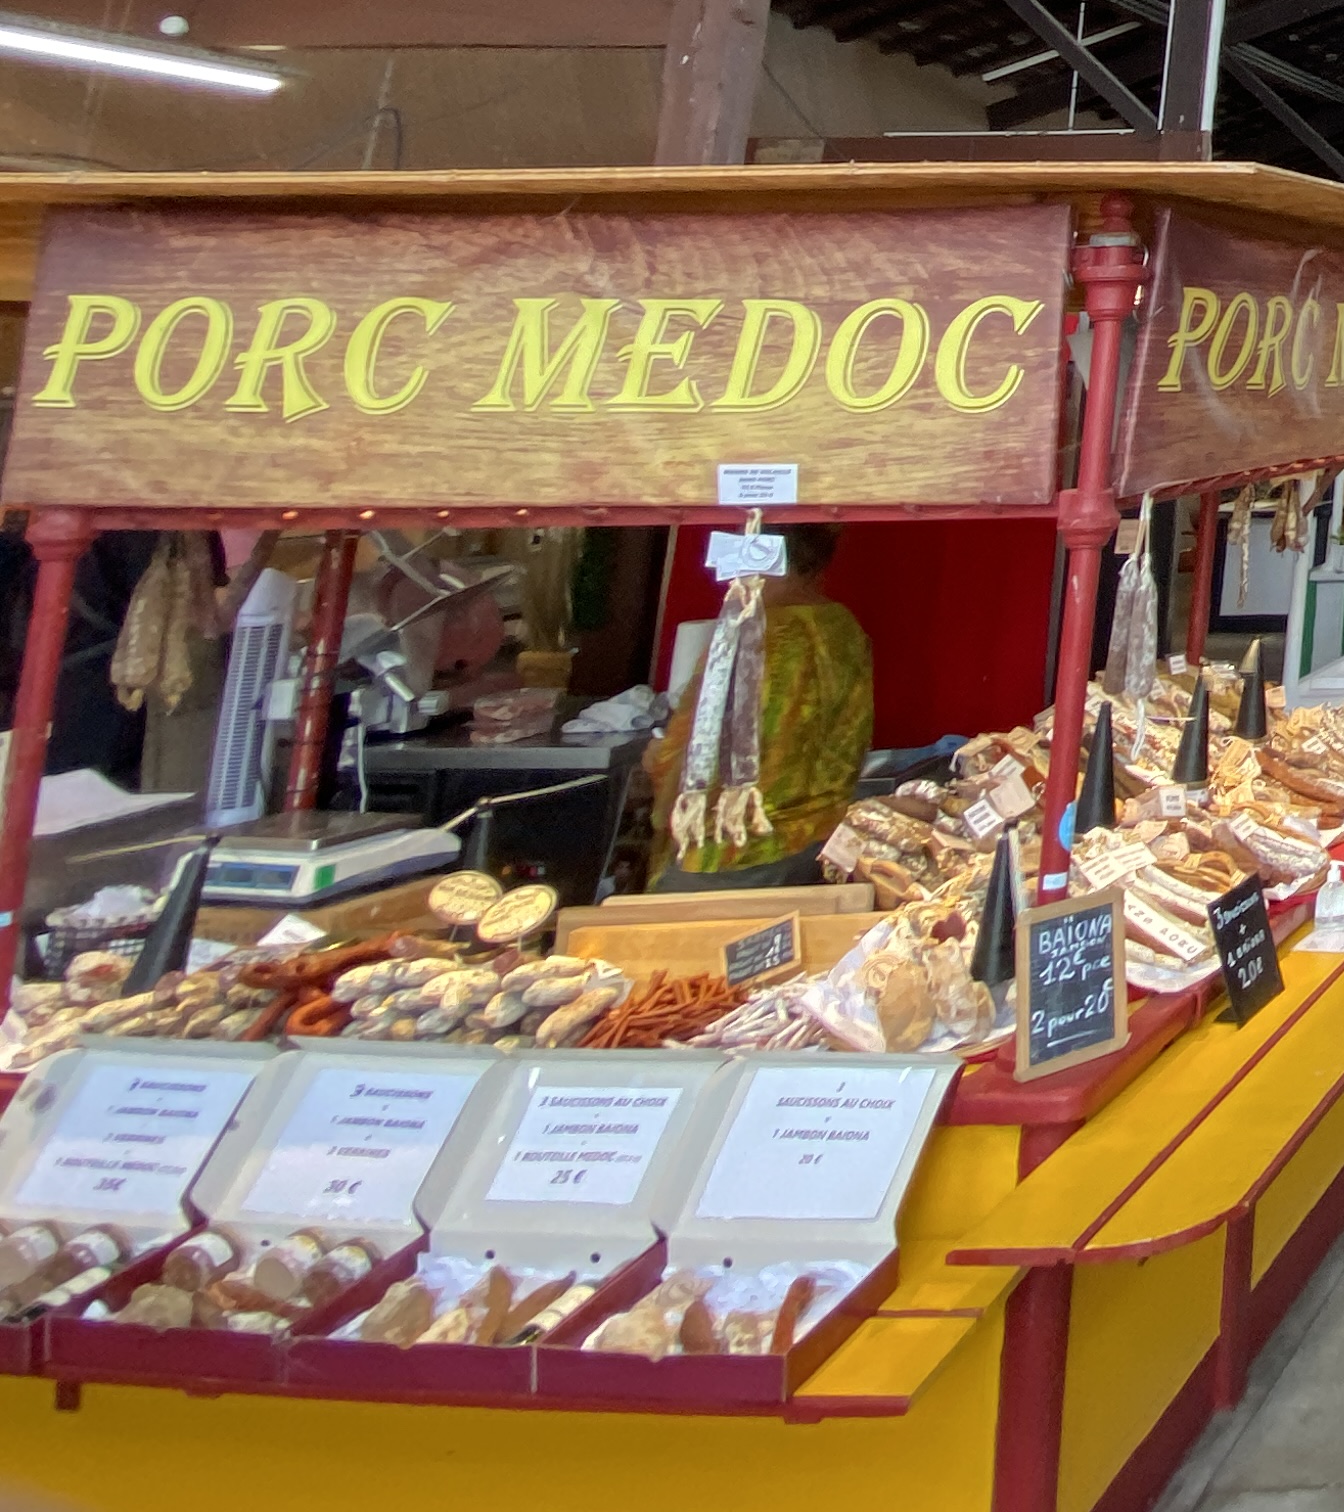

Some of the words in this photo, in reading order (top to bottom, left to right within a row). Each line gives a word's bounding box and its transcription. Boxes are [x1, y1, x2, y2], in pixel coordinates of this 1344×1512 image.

[1157, 286, 1320, 399] PORC
[31, 294, 456, 424] PORC
[469, 295, 1045, 414] MEDOC
[1038, 913, 1113, 955] BAÏONA
[1031, 1009, 1046, 1035] 2
[1047, 1008, 1085, 1039] pour
[775, 1096, 842, 1108] SAUCISSONS
[839, 1097, 860, 1109] AU
[858, 1098, 897, 1110] CHOIX
[778, 1128, 827, 1140] JAMBON
[550, 1169, 574, 1185] 25
